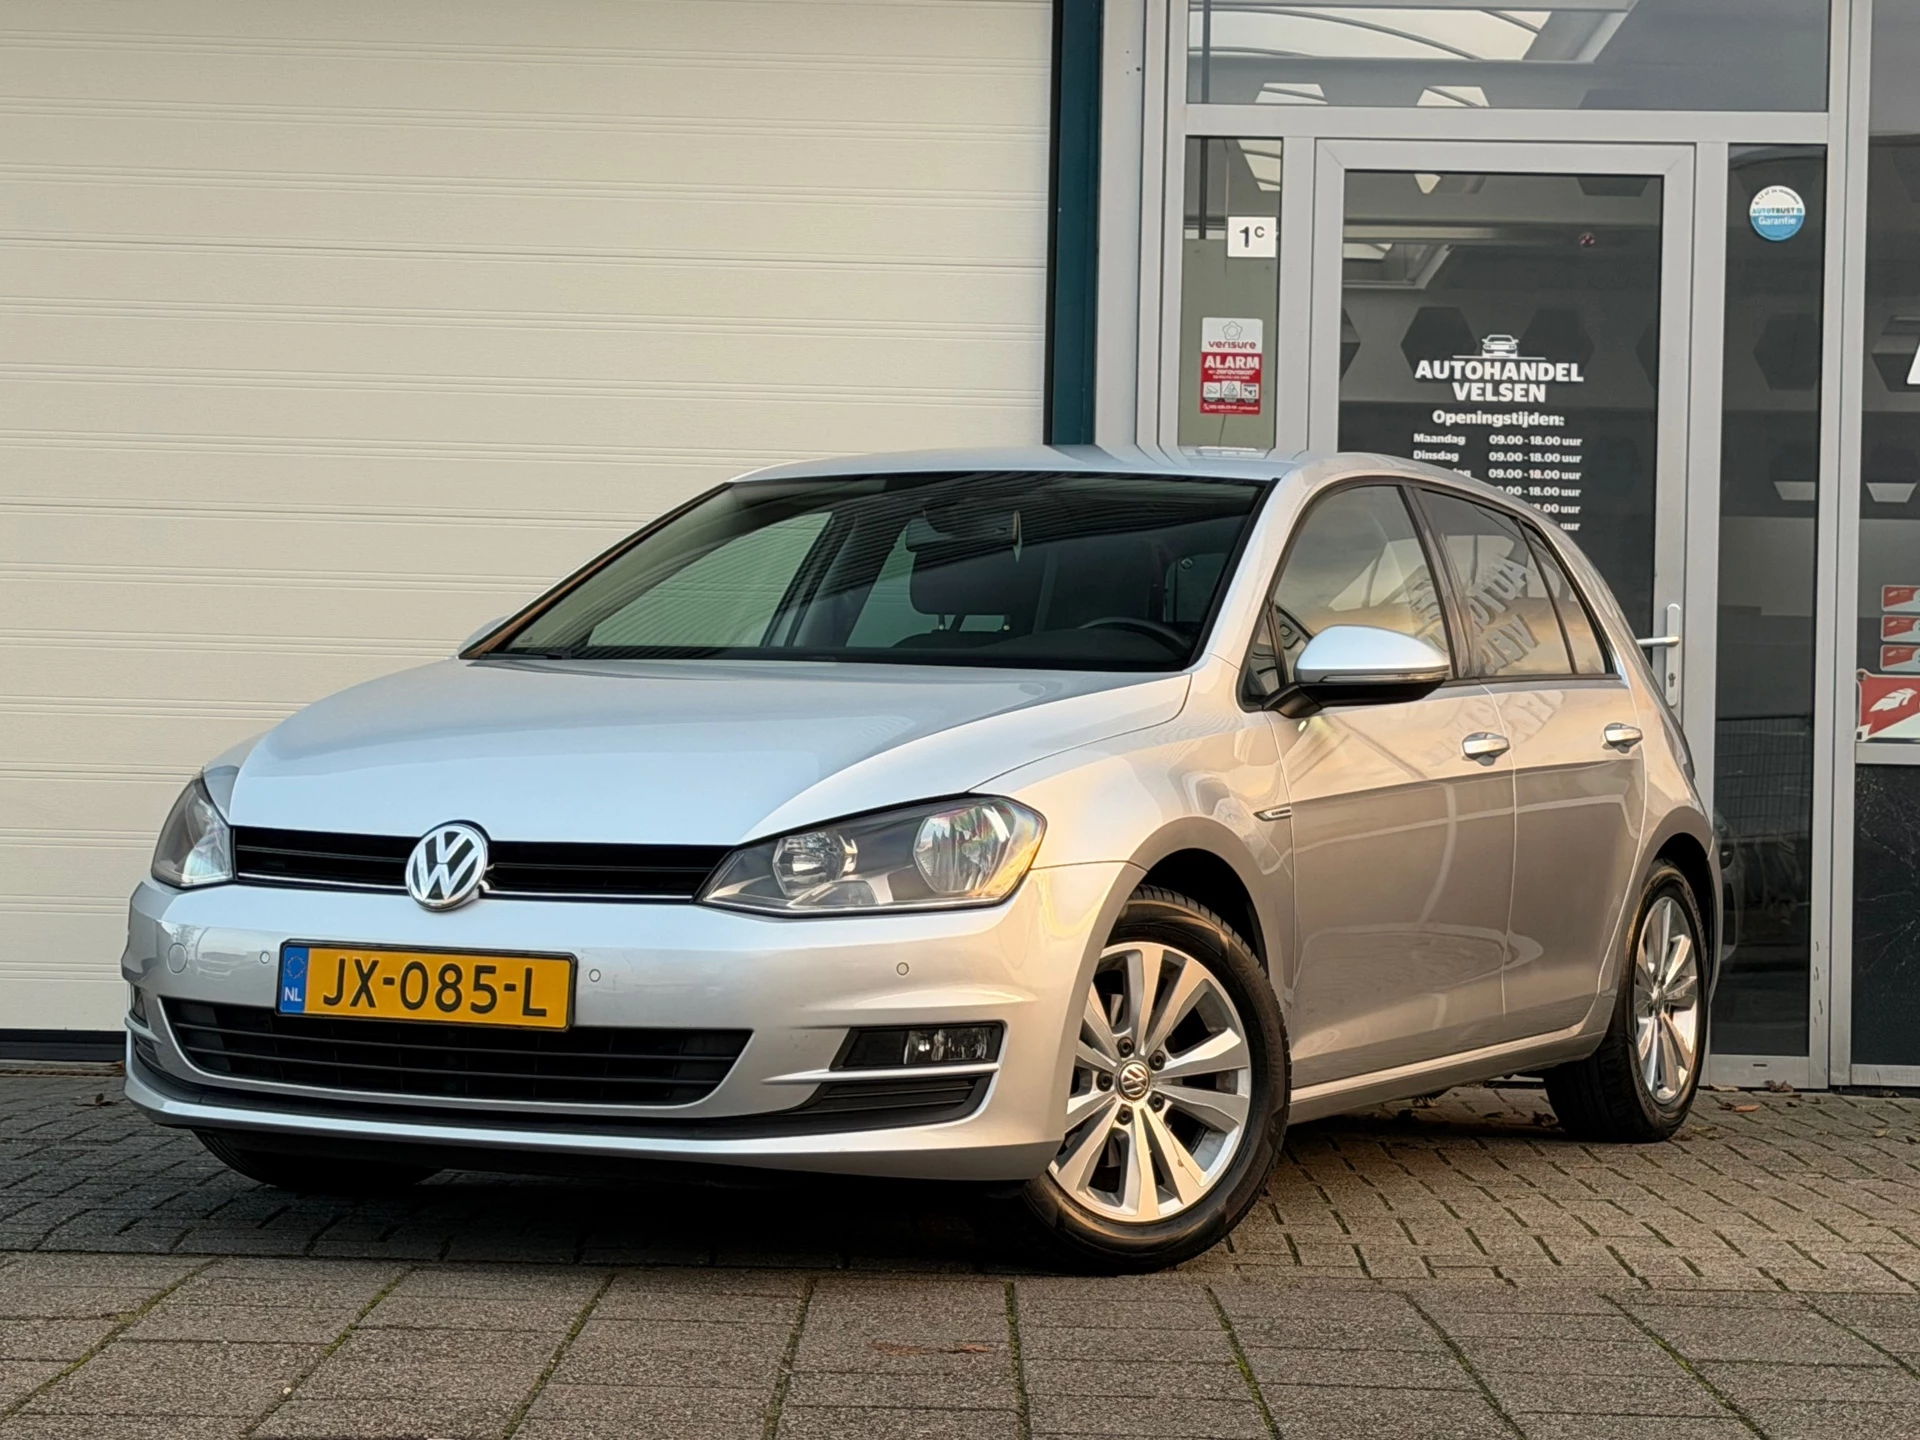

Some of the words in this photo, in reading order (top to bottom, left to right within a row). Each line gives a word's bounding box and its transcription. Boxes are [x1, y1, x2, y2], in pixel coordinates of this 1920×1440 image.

[1758, 216, 1797, 225] Garantie
[1208, 341, 1257, 349] verisure
[1204, 355, 1260, 369] ALARM
[1414, 360, 1584, 382] AUTOHANDEL
[1452, 382, 1546, 403] VELSEN
[1432, 410, 1565, 428] Openingstijden:
[1413, 433, 1466, 446] Maandag
[1489, 435, 1523, 445] 09.00
[1529, 436, 1561, 446] 18.00
[1562, 438, 1583, 446] uur
[1413, 450, 1459, 462] Dinsdag
[1488, 452, 1523, 461] 09.00
[1529, 453, 1560, 462] 18.00
[1561, 455, 1582, 463] uur
[1488, 469, 1523, 478] 09.00
[1529, 470, 1560, 479] 18.00
[1561, 472, 1582, 480] uur
[1528, 487, 1560, 496] 18.00
[1561, 489, 1582, 497] uur
[1530, 503, 1560, 513] 8.00
[284, 986, 302, 1002] NL
[322, 957, 548, 1018] JX-085-L
